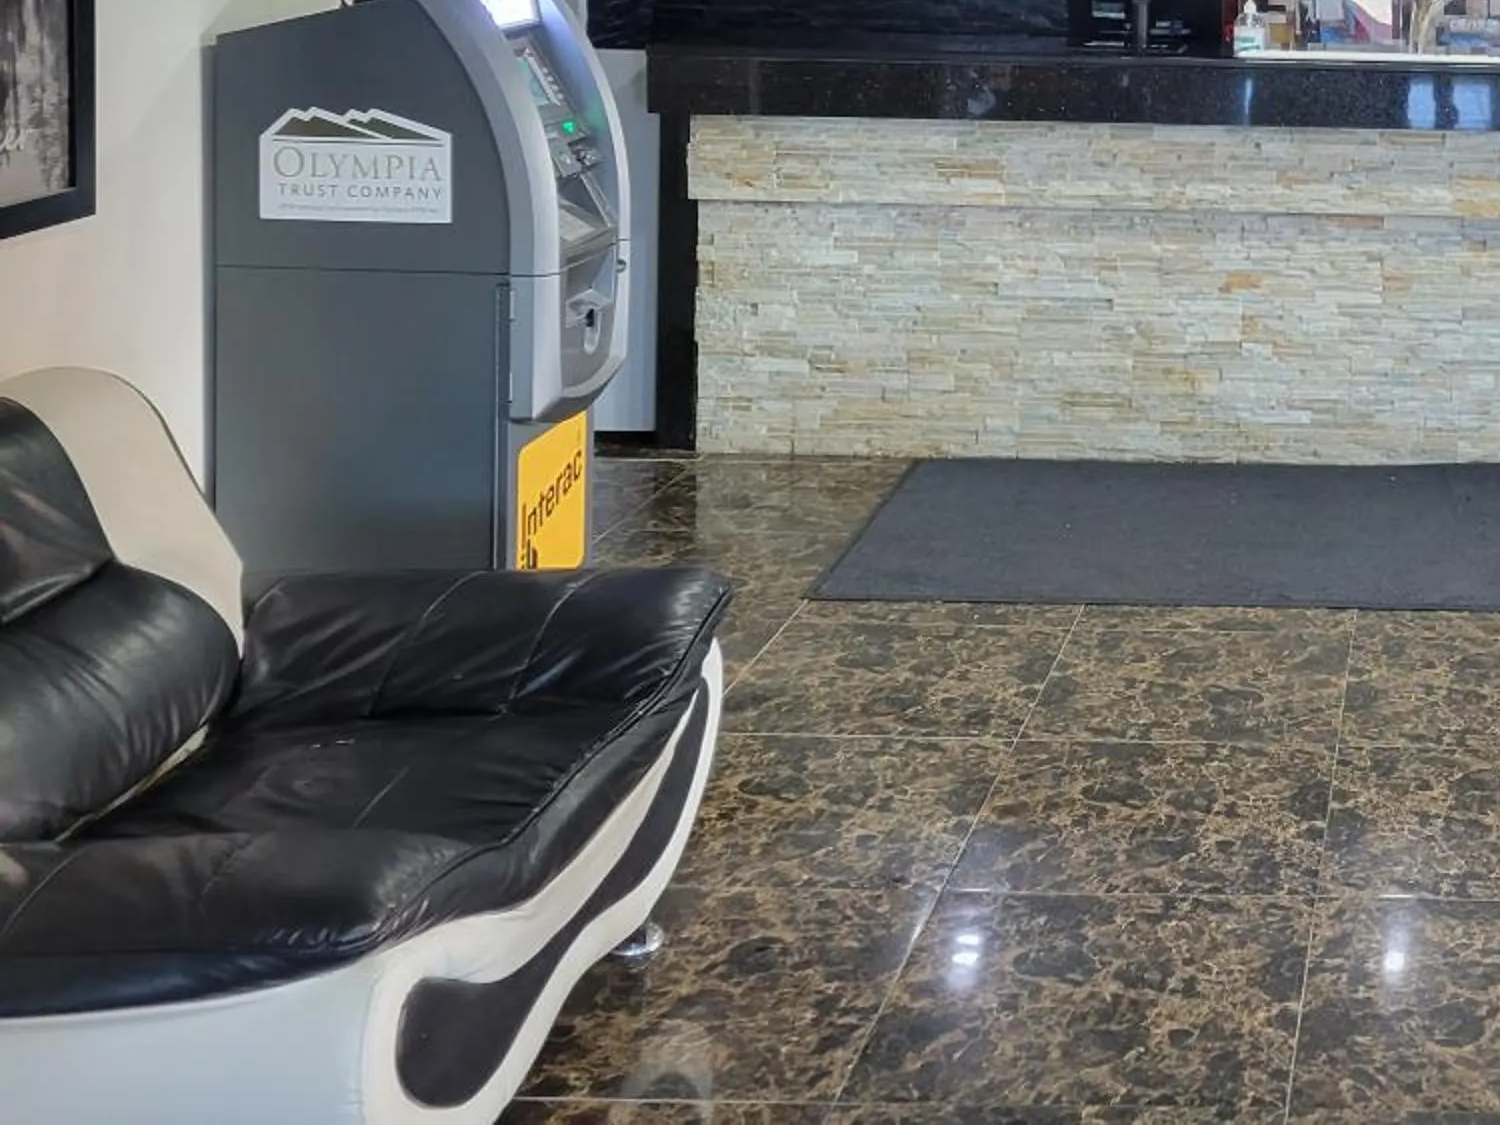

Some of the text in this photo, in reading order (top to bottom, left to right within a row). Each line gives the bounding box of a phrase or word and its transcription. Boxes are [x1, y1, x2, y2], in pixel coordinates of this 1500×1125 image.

[273, 146, 444, 182] OLYMPIA
[279, 182, 442, 201] TRUST COMPANY
[521, 449, 583, 551] Interac
